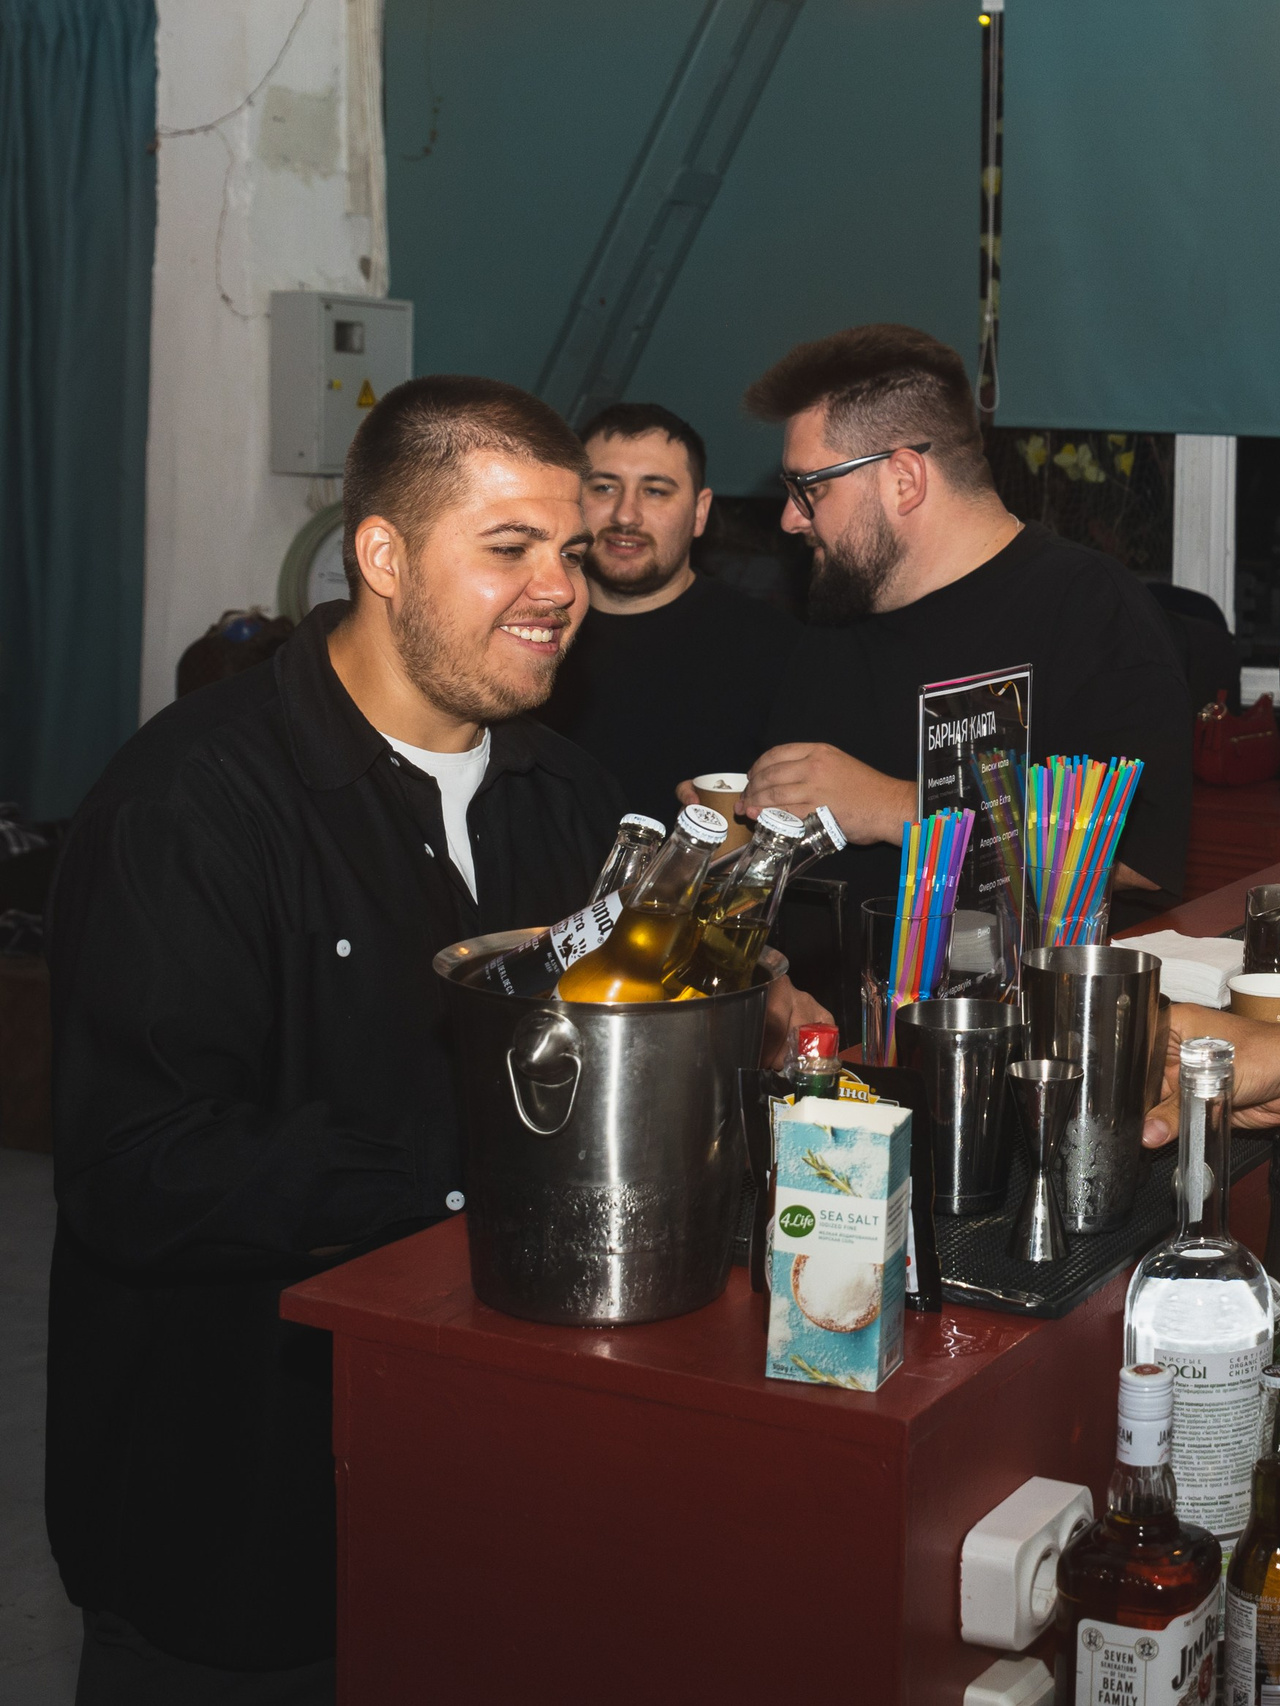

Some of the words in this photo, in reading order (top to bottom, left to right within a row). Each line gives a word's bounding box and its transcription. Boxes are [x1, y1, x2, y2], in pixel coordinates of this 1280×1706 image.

[928, 718, 968, 751] БАРНАЯ
[970, 711, 997, 740] КАРТА
[981, 763, 997, 774] Виски
[997, 758, 1010, 769] кола
[928, 774, 956, 789] Мичелада
[980, 800, 999, 811] Corona
[999, 794, 1011, 805] Extra
[979, 836, 1002, 849] Апероль
[1002, 828, 1019, 842] спритз
[978, 881, 996, 893] Фиеро
[996, 875, 1011, 887] тоник
[573, 912, 585, 931] tra
[591, 900, 614, 935] ona
[977, 927, 991, 938] Вино
[820, 1210, 843, 1222] SEA
[848, 1213, 879, 1226] SALT
[1163, 1355, 1202, 1365] ЧИСТЫЕ
[1229, 1358, 1258, 1370] ORGANIC
[1229, 1365, 1258, 1377] CHISTI
[1104, 1650, 1134, 1664] SEVEN
[1172, 1632, 1204, 1691] JIM
[1100, 1661, 1137, 1673] GENERATIONS
[1102, 1677, 1134, 1694] BEAM
[1098, 1690, 1138, 1706] FAMILY
